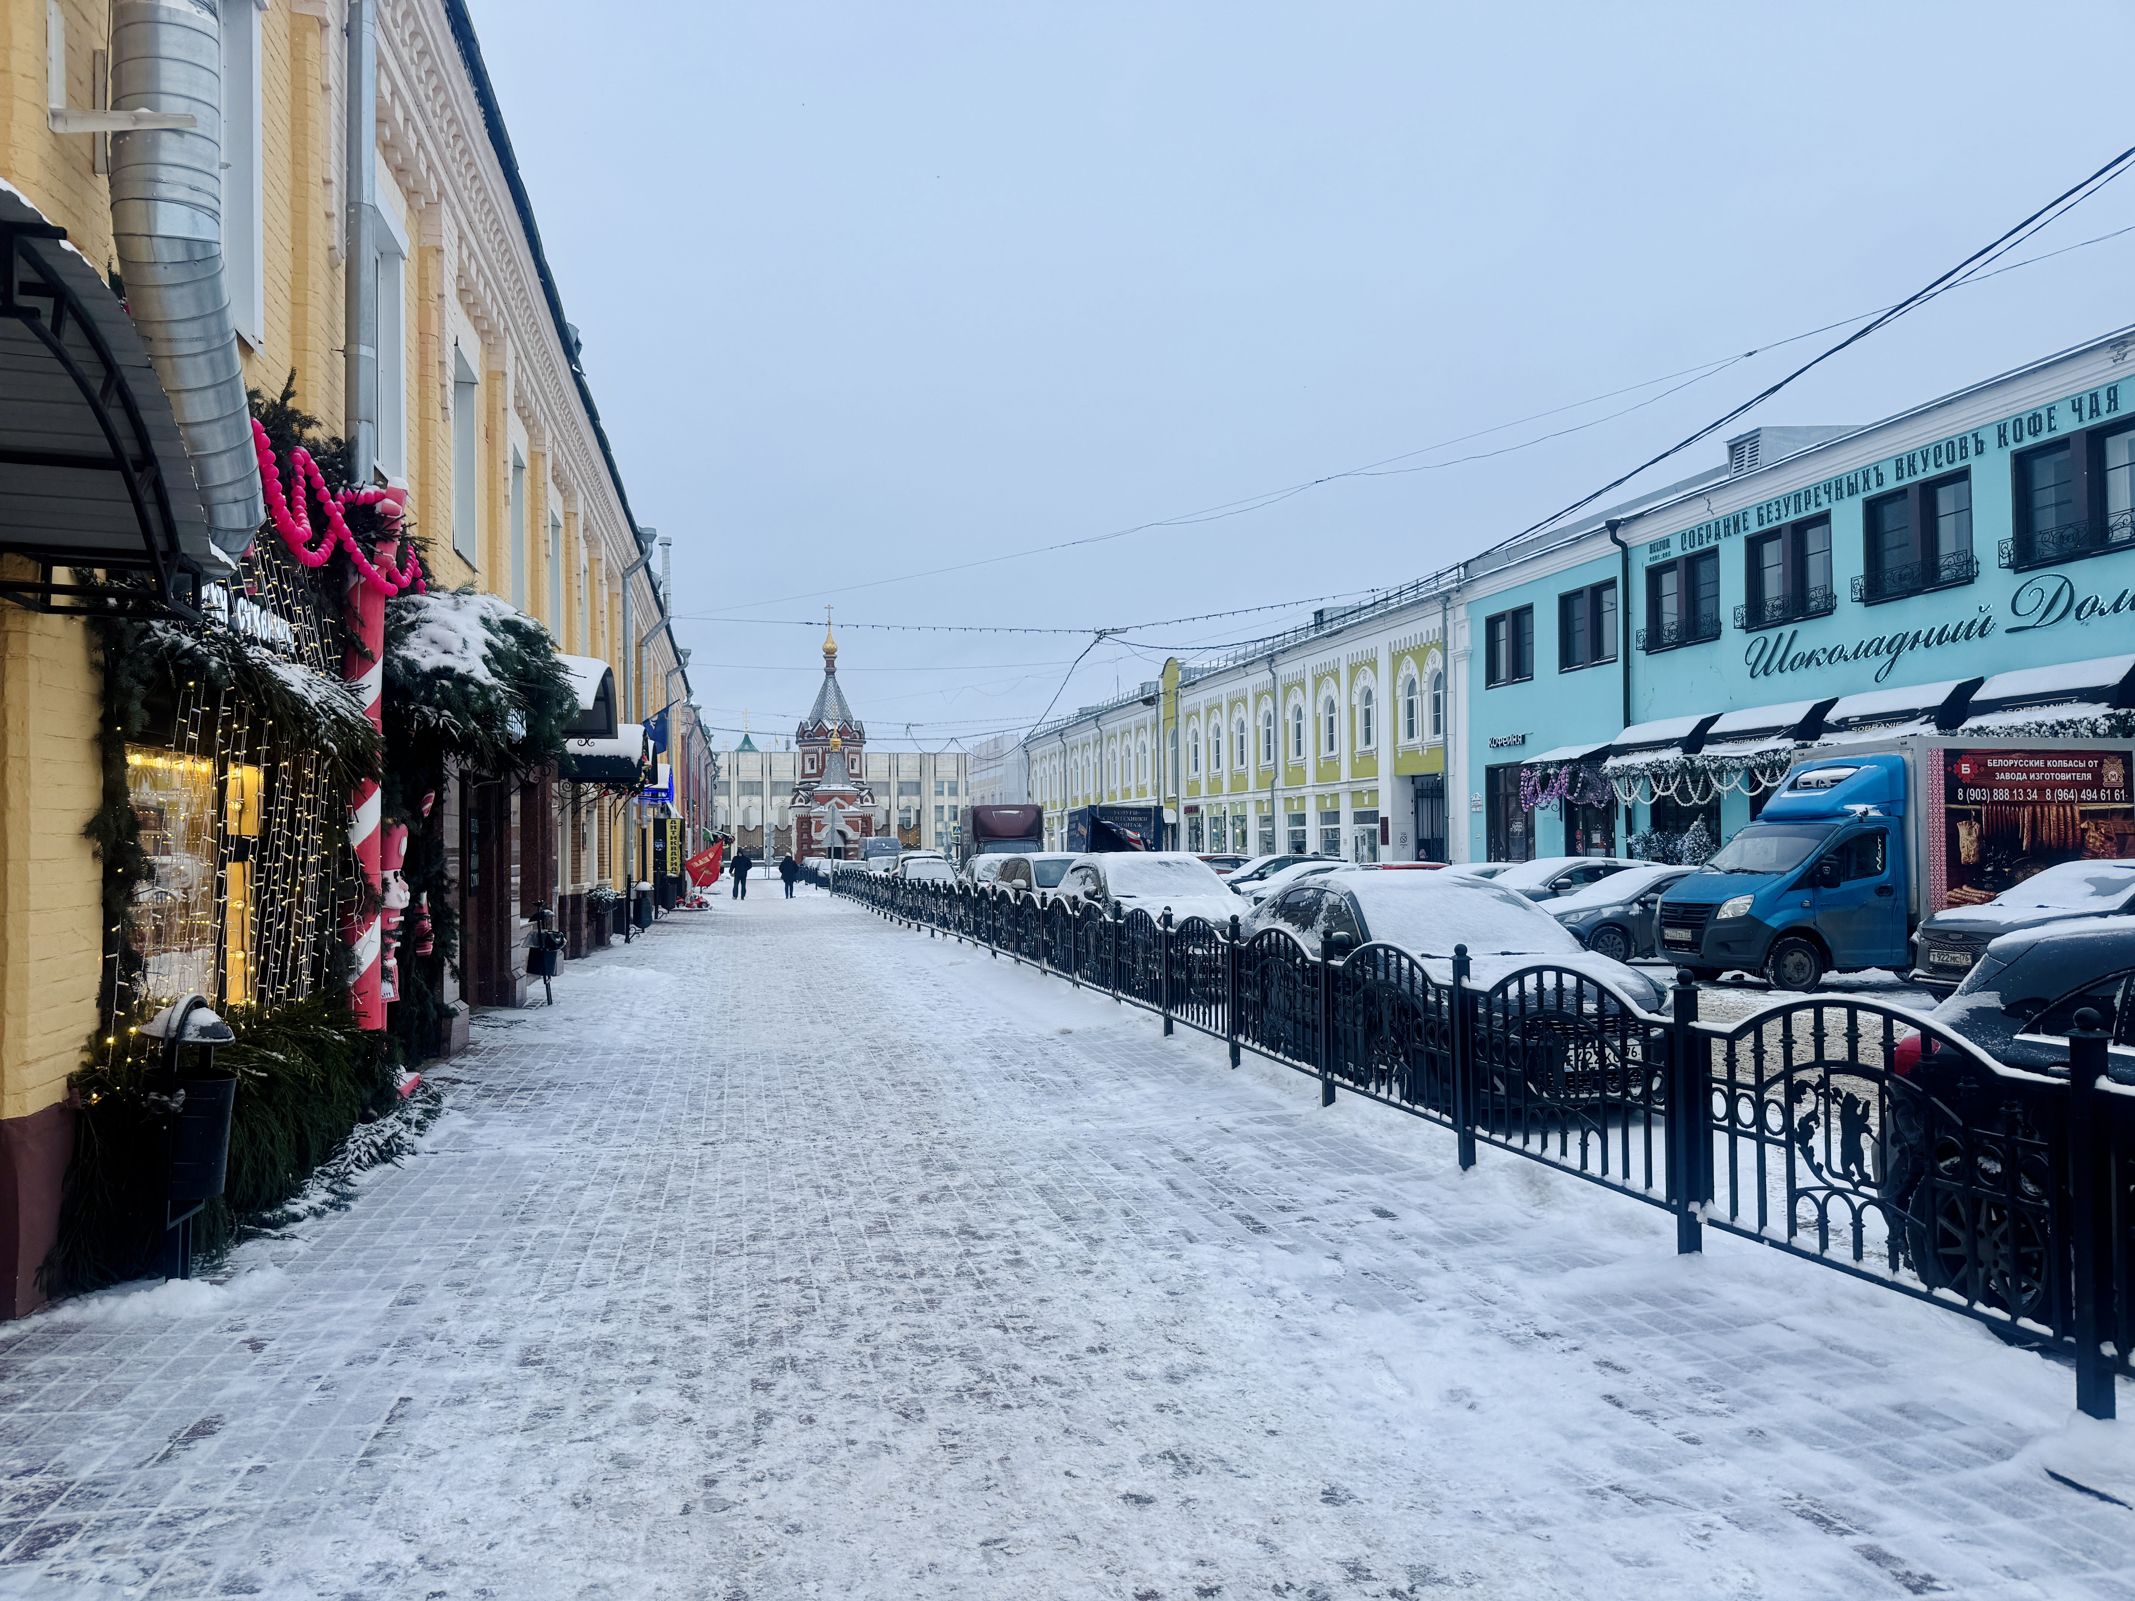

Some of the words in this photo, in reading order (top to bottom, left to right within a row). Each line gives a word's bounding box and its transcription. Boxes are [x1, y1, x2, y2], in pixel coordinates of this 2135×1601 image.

[1681, 511, 1749, 551] СОБРАНИЕ
[1757, 466, 1884, 527] БЕЗУПРЕЧНЫХЪ
[1895, 432, 1984, 481] ВКУСОВЪ
[1996, 405, 2058, 449] КОФЕ
[2070, 384, 2119, 423] ЧАЯ
[1745, 603, 1996, 683] Шоколадный
[1961, 764, 1970, 774] Б
[1987, 759, 2045, 768] БЕЛОРУССКИЕ
[2047, 759, 2086, 768] КОЛБАСЫ
[2088, 760, 2098, 768] ОТ
[1995, 772, 2027, 781] ЗАВОДА
[2029, 772, 2092, 781] ИЗГОТОВИТЕЛЯ
[1957, 788, 1963, 800] 8
[1966, 788, 1990, 803] (903)
[1993, 788, 2009, 800] 888
[2013, 788, 2024, 800] 13
[2026, 788, 2038, 800] 34
[2045, 788, 2051, 800] 8
[2054, 788, 2078, 803] (964)
[2080, 788, 2097, 800] 494
[2100, 788, 2111, 800] 61
[2114, 788, 2125, 800] 61
[669, 819, 678, 873] АНТИКВАРИА
